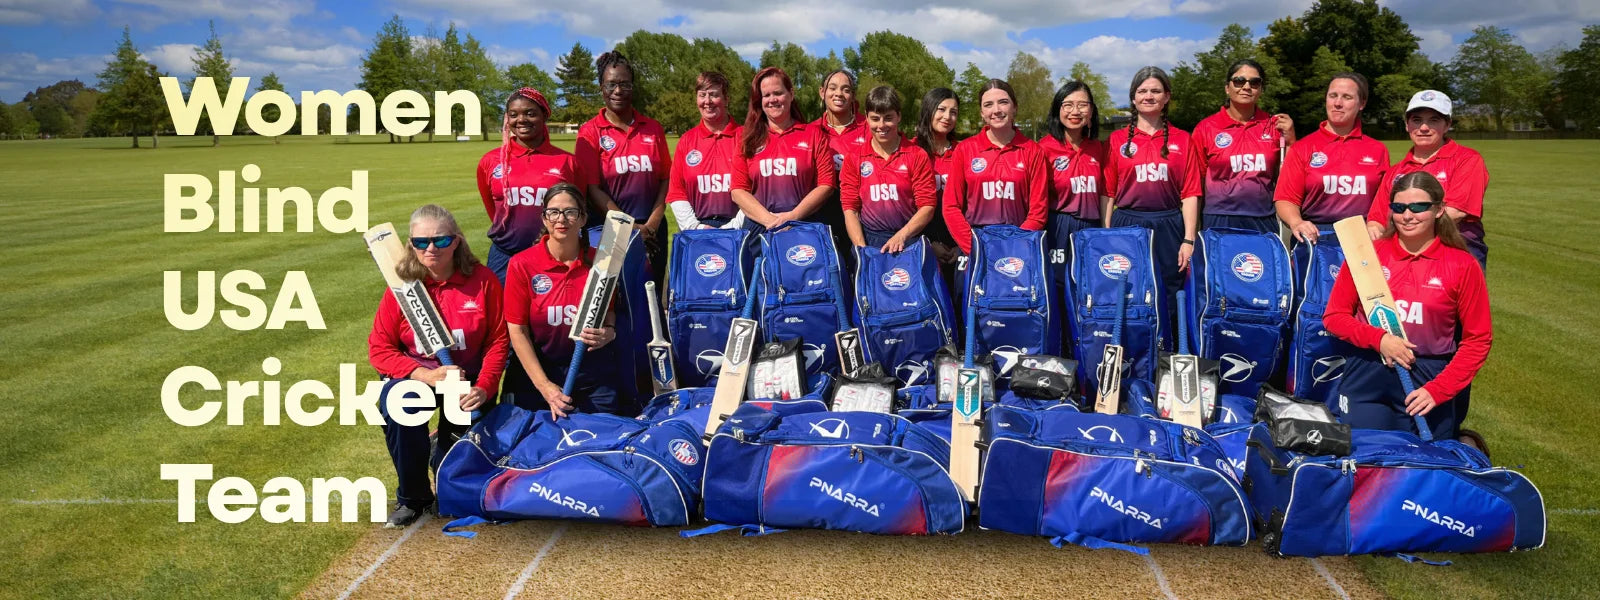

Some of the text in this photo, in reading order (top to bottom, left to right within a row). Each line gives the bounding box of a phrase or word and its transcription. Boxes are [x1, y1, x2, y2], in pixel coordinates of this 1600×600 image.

[614, 155, 652, 174] USA
[760, 158, 797, 177] USA
[1135, 163, 1168, 183] USA
[1230, 154, 1267, 173] USA
[697, 173, 731, 194] USA
[869, 183, 899, 202] USA
[983, 181, 1015, 200] USA
[1070, 175, 1097, 194] USA
[1323, 175, 1367, 195] USA
[507, 186, 548, 207] USA
[1050, 249, 1065, 264] 35
[406, 287, 440, 346] PNARRA
[547, 305, 578, 326] US
[1395, 299, 1424, 325] SA
[529, 482, 600, 517] PNARRA
[809, 477, 879, 517] PNARRA
[1090, 487, 1162, 529] PNARRA
[1402, 500, 1475, 538] PNARRA
